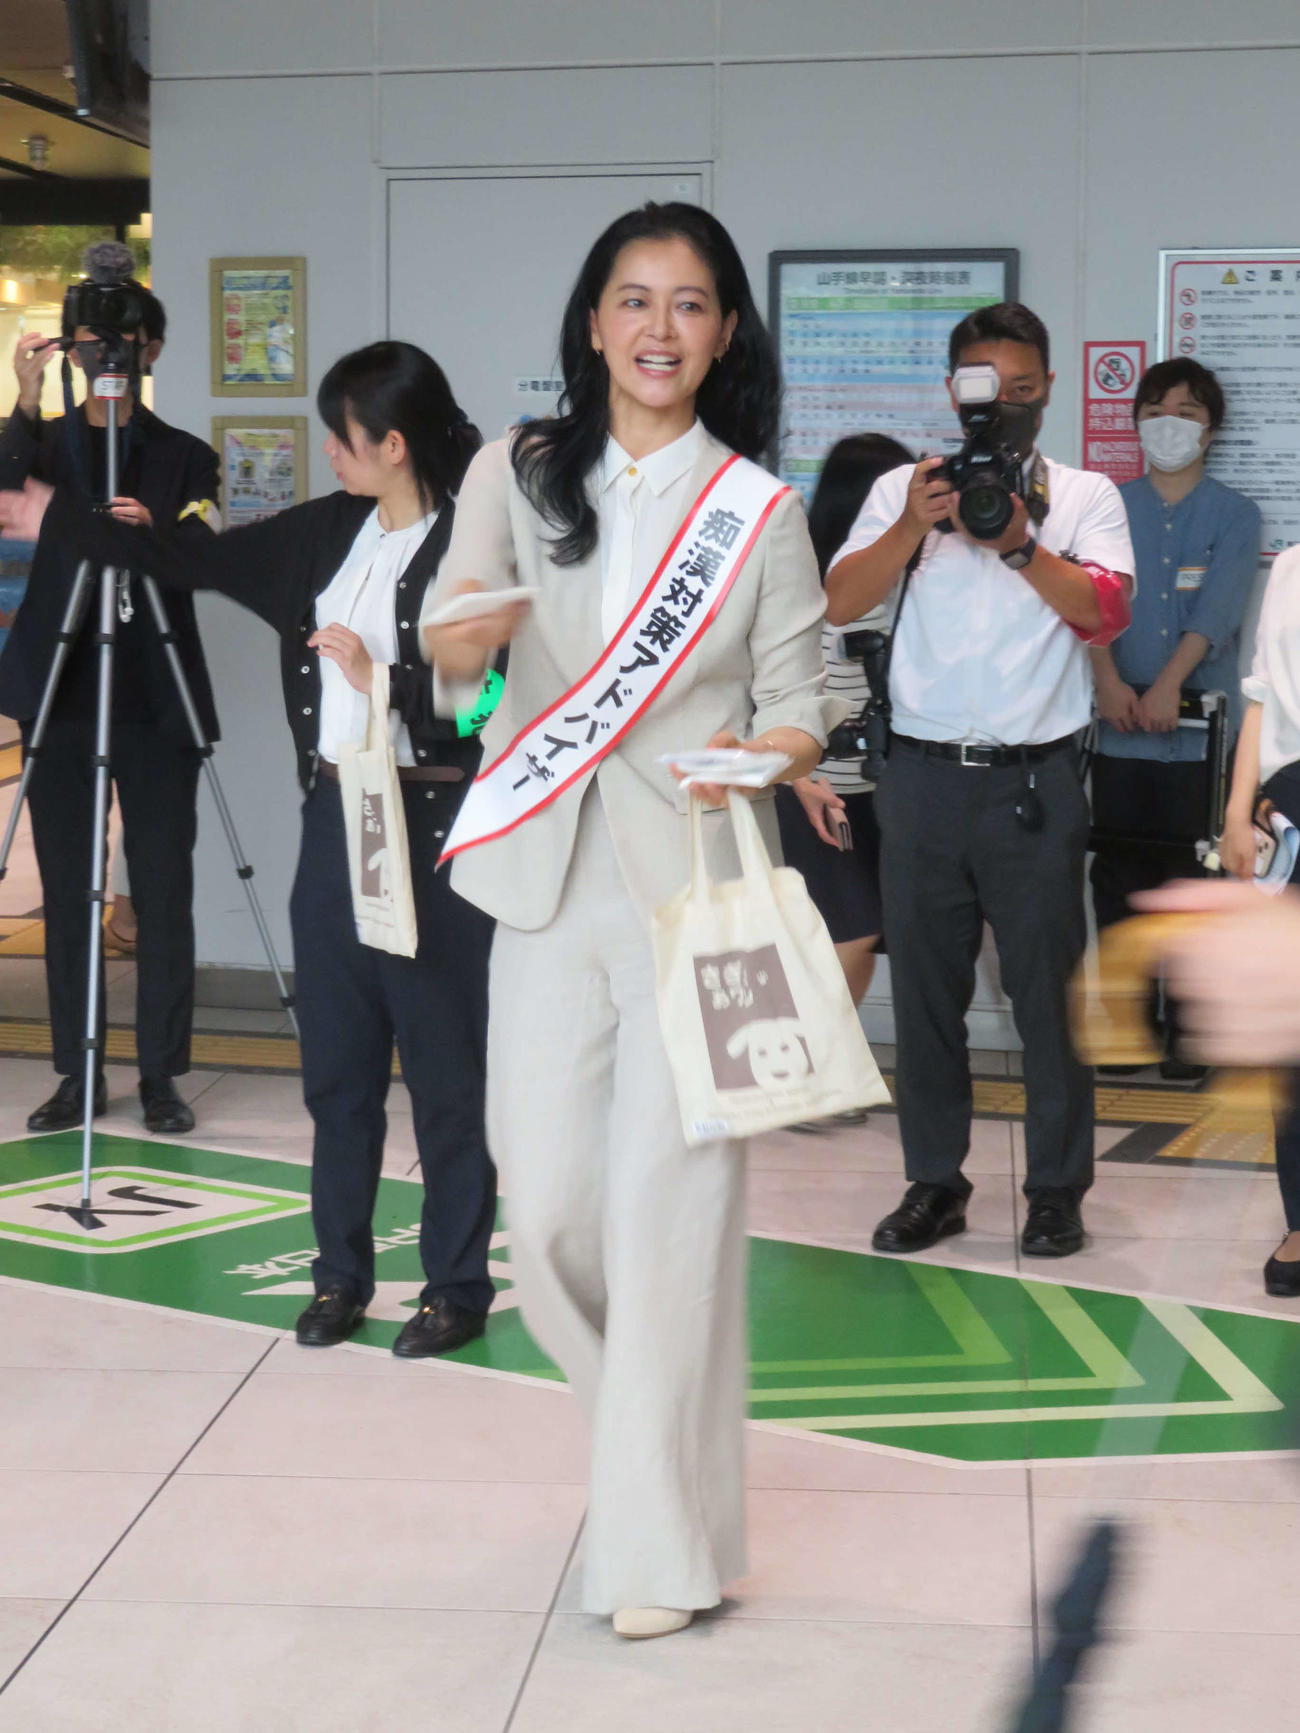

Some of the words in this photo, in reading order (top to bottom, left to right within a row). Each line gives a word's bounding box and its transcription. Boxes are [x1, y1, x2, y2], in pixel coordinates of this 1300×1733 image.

[512, 507, 745, 792] 痴漢対策アドバイザー
[31, 1185, 203, 1231] JY
